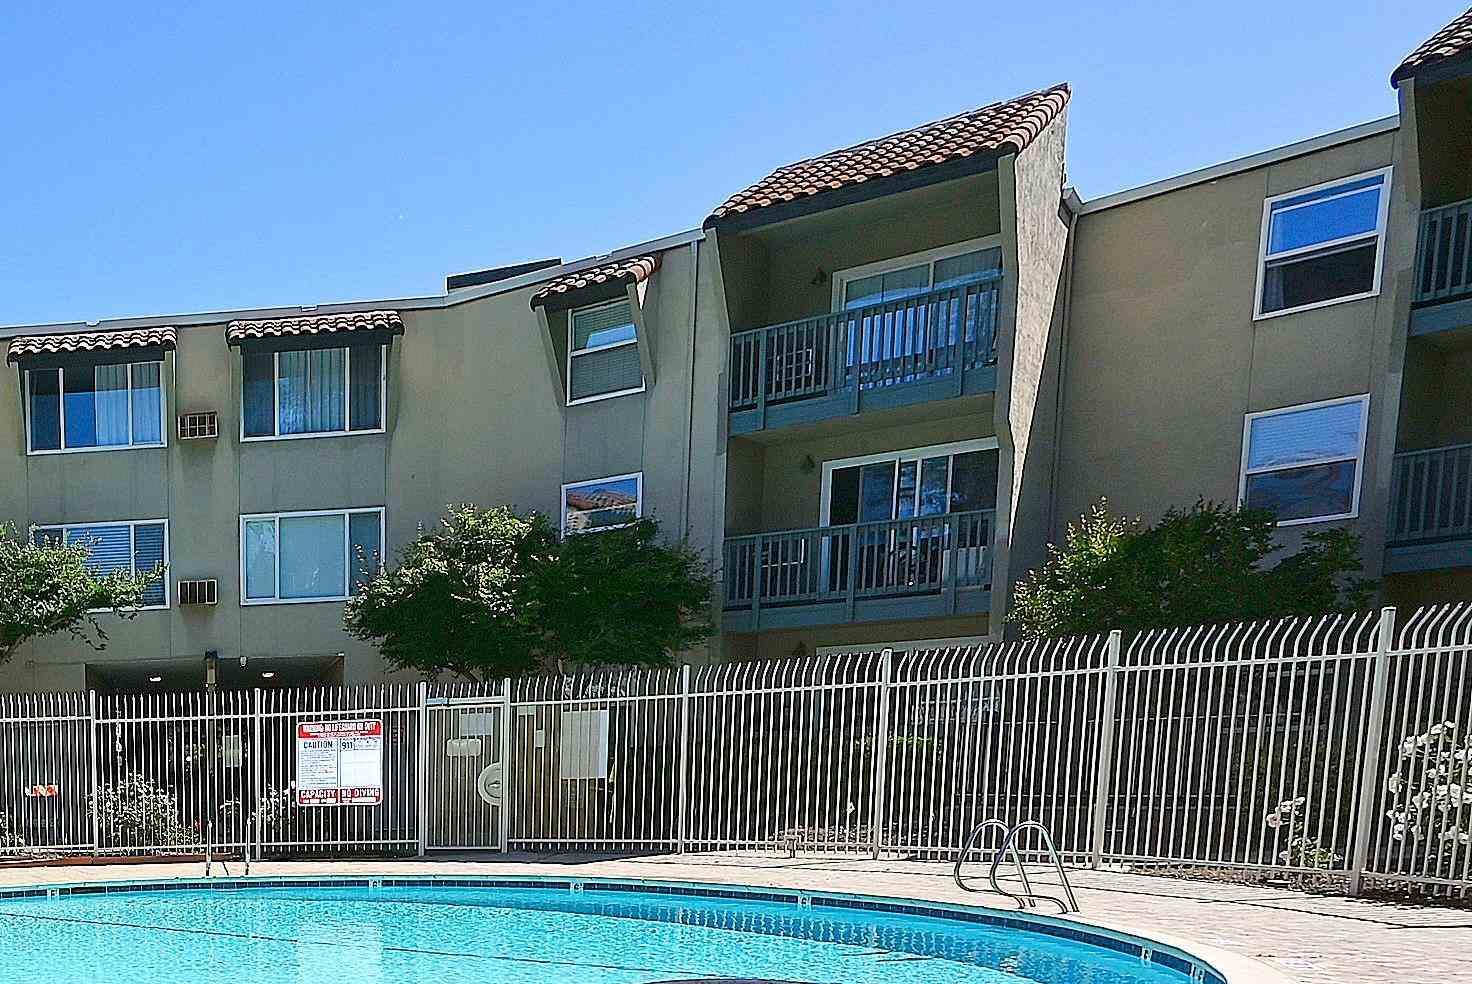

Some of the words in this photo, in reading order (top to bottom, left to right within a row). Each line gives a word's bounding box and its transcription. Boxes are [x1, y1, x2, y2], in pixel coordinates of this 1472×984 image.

[304, 740, 333, 749] CAUTION
[341, 742, 353, 750] 911
[300, 789, 336, 798] CAPACITY
[354, 788, 380, 797] DIVING
